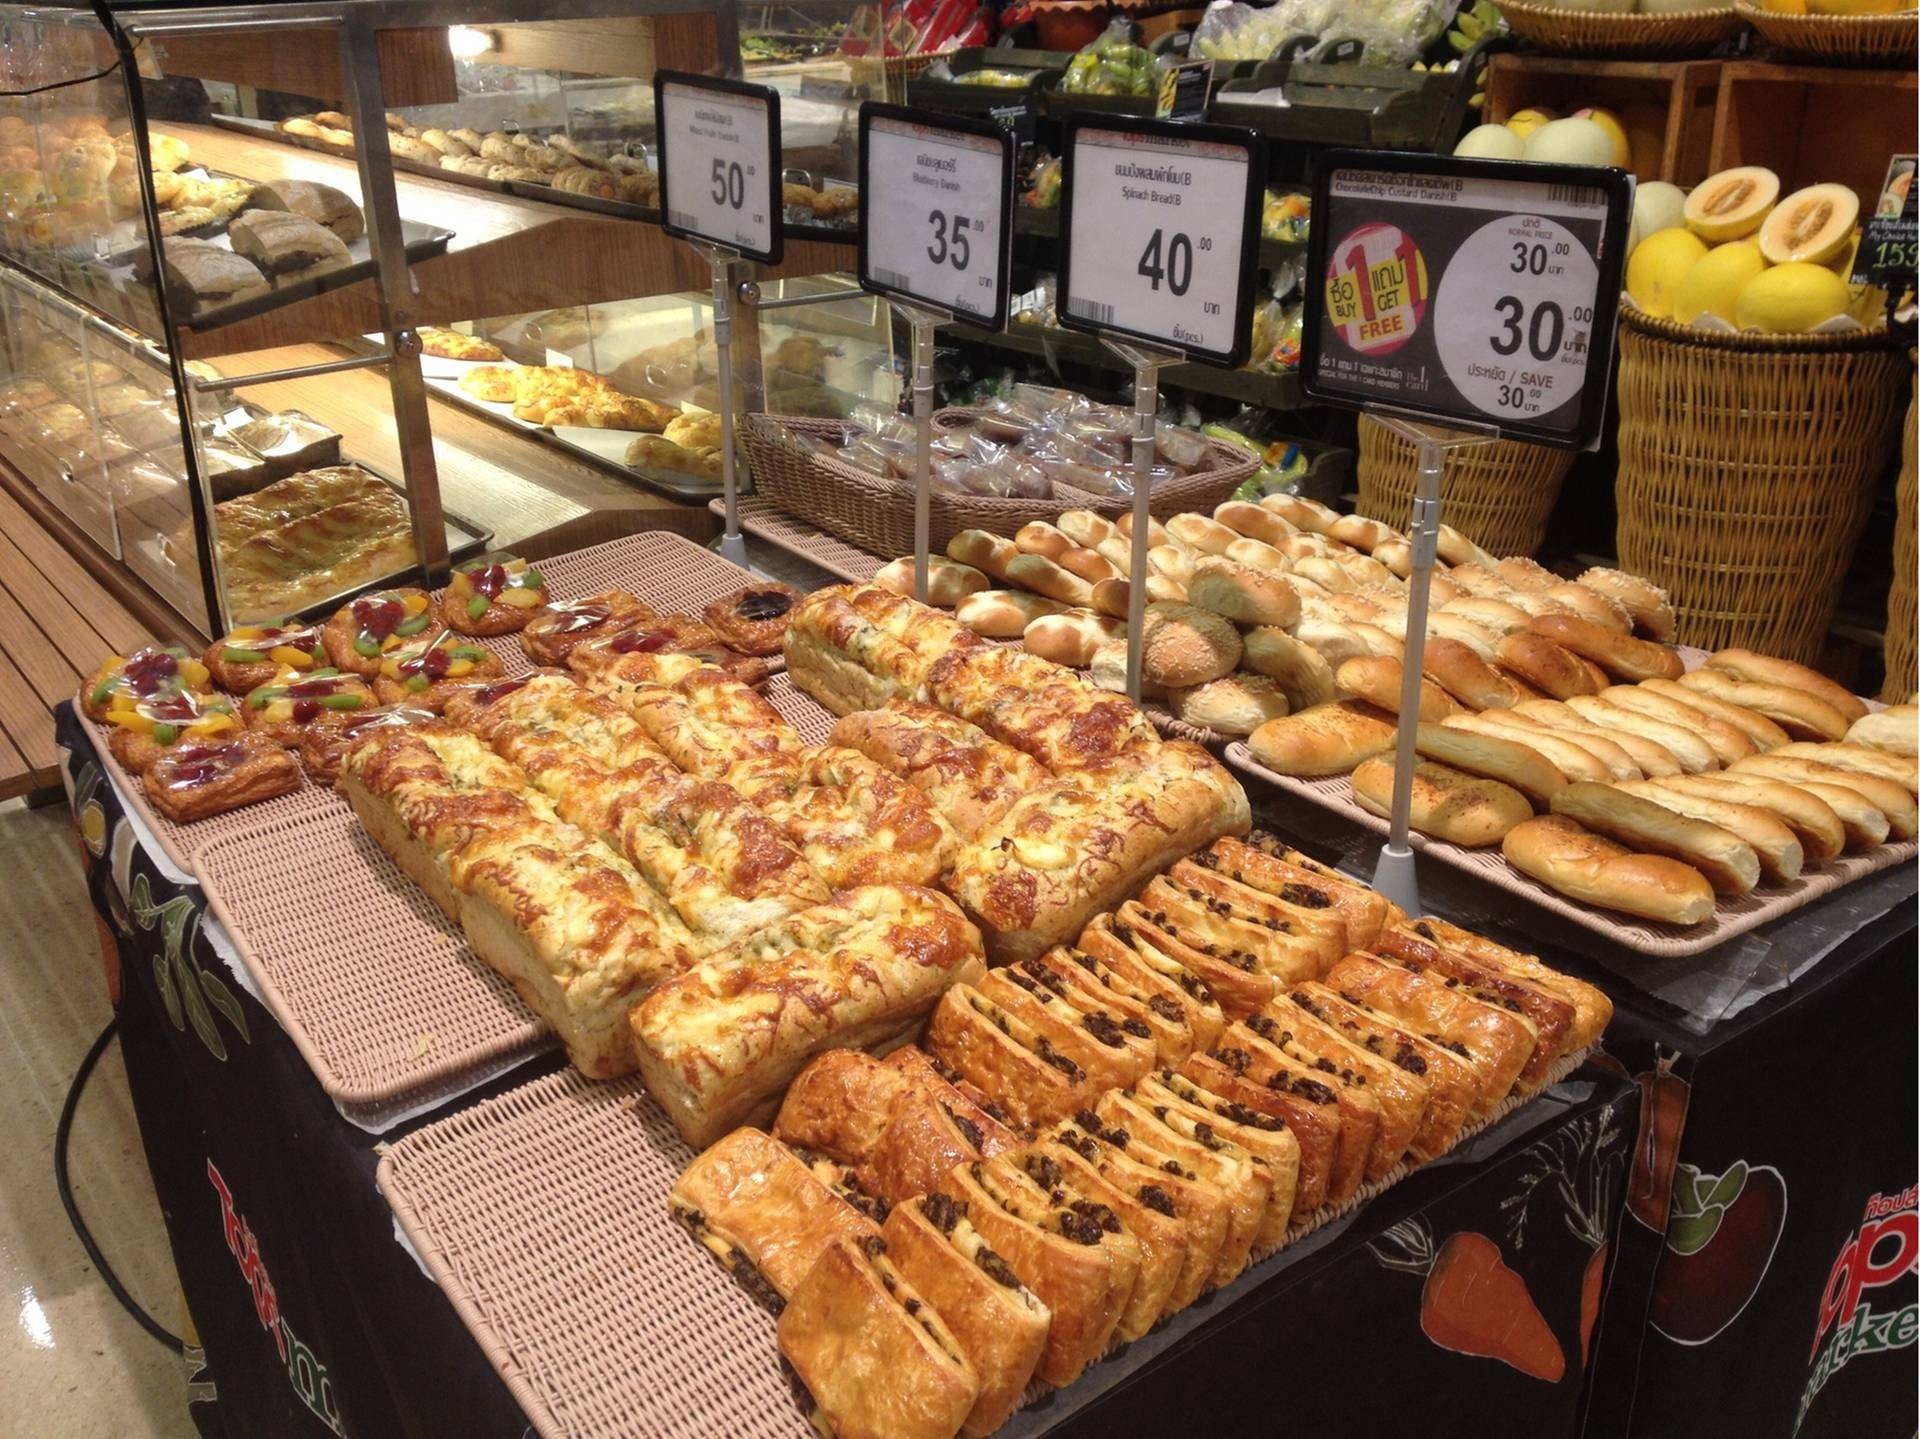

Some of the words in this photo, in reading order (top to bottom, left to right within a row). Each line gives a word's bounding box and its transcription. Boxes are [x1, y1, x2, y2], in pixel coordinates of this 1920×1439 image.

[711, 157, 745, 210] 50
[1122, 185, 1149, 202] Spinach
[1387, 185, 1418, 199] Custard
[927, 209, 970, 271] 35
[1534, 230, 1554, 240] PRICE
[1137, 227, 1193, 297] 40
[1510, 241, 1548, 276] 30
[1371, 262, 1405, 293] แถม
[1203, 301, 1221, 316] บาท
[1335, 302, 1358, 319] BUY
[1376, 289, 1400, 313] GET
[1359, 314, 1403, 341] FREE
[1489, 295, 1565, 363] 30
[1467, 363, 1506, 382] ประหยัด
[1520, 371, 1554, 389] SAVE
[1497, 384, 1524, 409] 30
